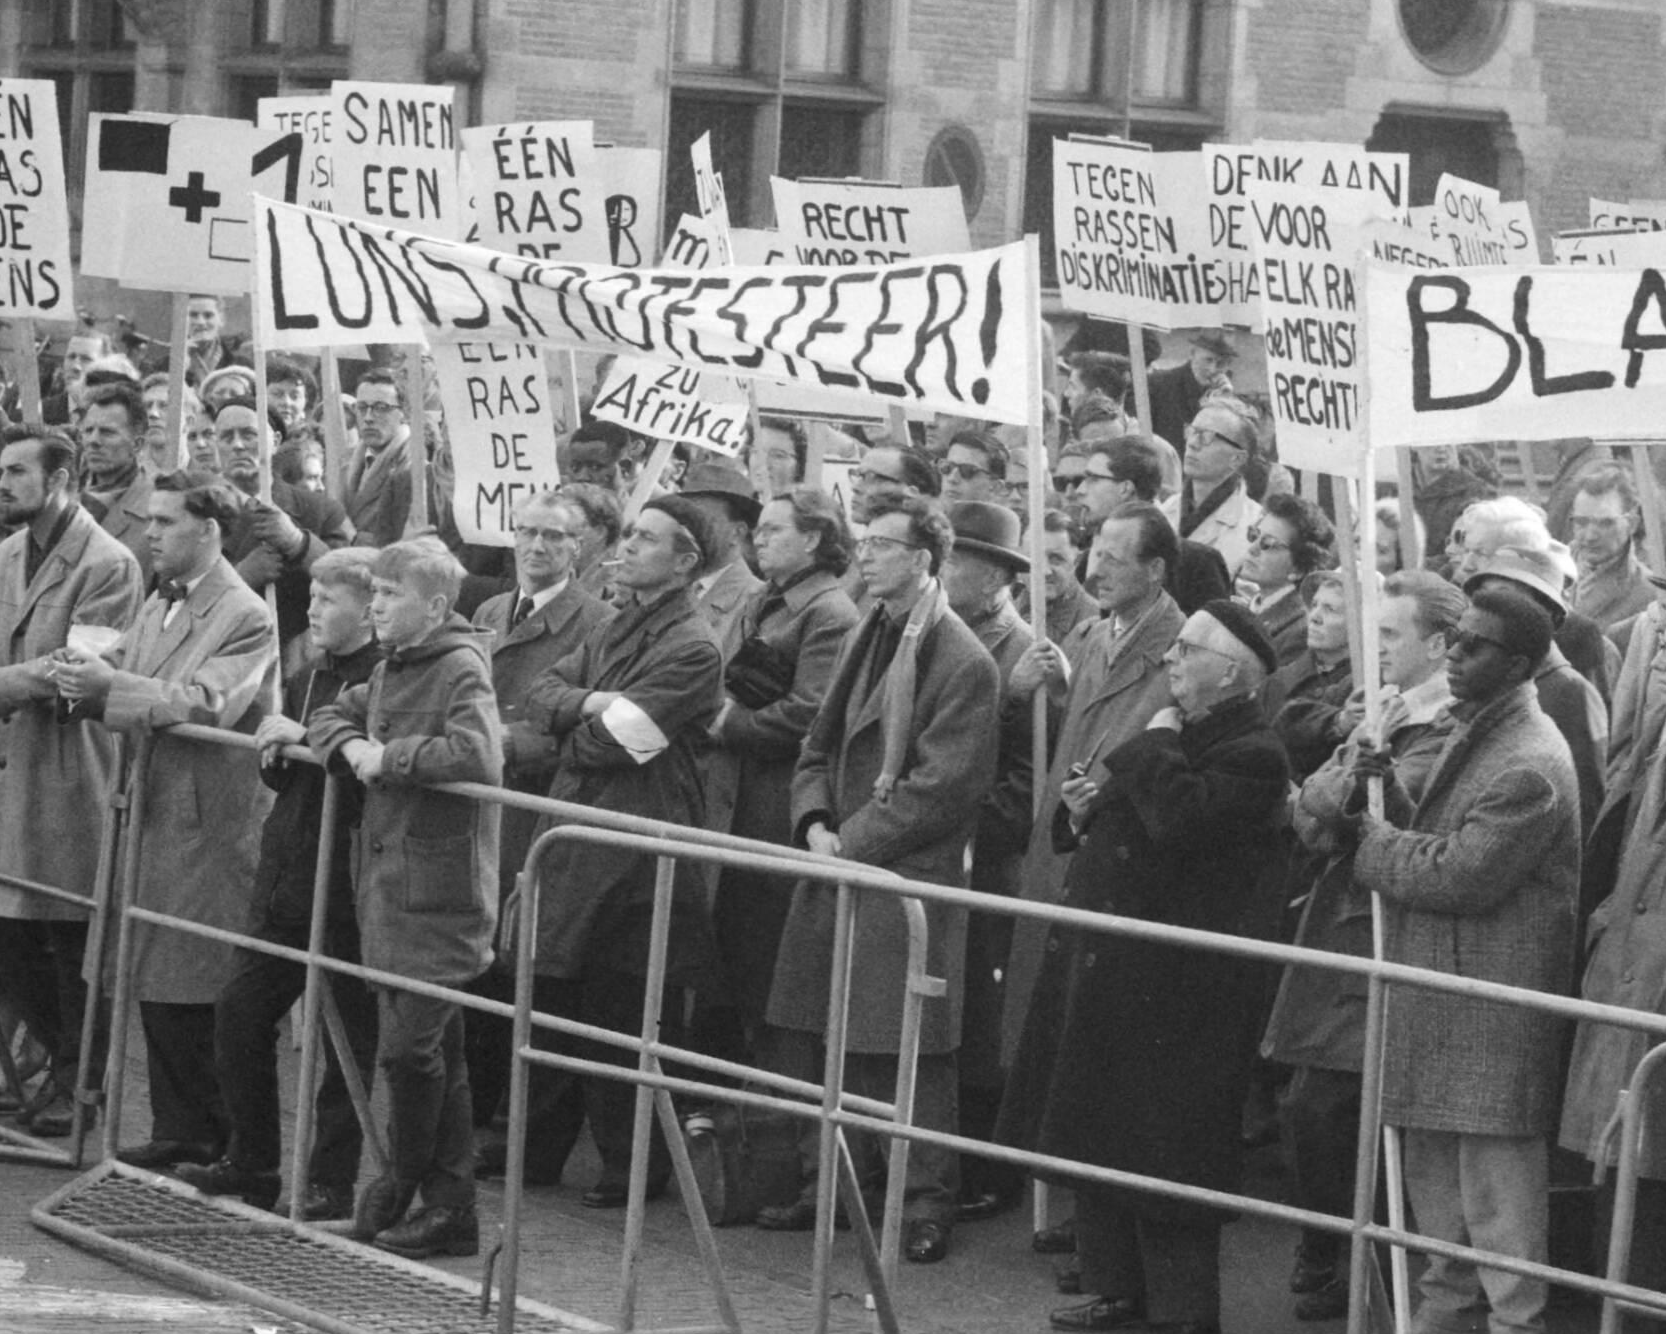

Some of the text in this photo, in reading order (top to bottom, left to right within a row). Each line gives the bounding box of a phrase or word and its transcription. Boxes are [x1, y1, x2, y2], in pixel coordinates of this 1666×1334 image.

[344, 92, 454, 150] SAMEN
[493, 125, 575, 180] ÉÉN
[1214, 154, 1303, 196] DENK
[363, 164, 441, 220] EEN
[1066, 161, 1156, 207] TEGEN
[494, 187, 583, 234] RAS
[802, 201, 910, 243] RECHT
[1074, 207, 1178, 254] RASSEN
[1209, 203, 1248, 250] DE
[1251, 199, 1332, 252] VOOR
[1444, 189, 1491, 231] OOK
[1265, 257, 1319, 308] ELK
[467, 375, 541, 420] RAS
[491, 432, 533, 471] DE
